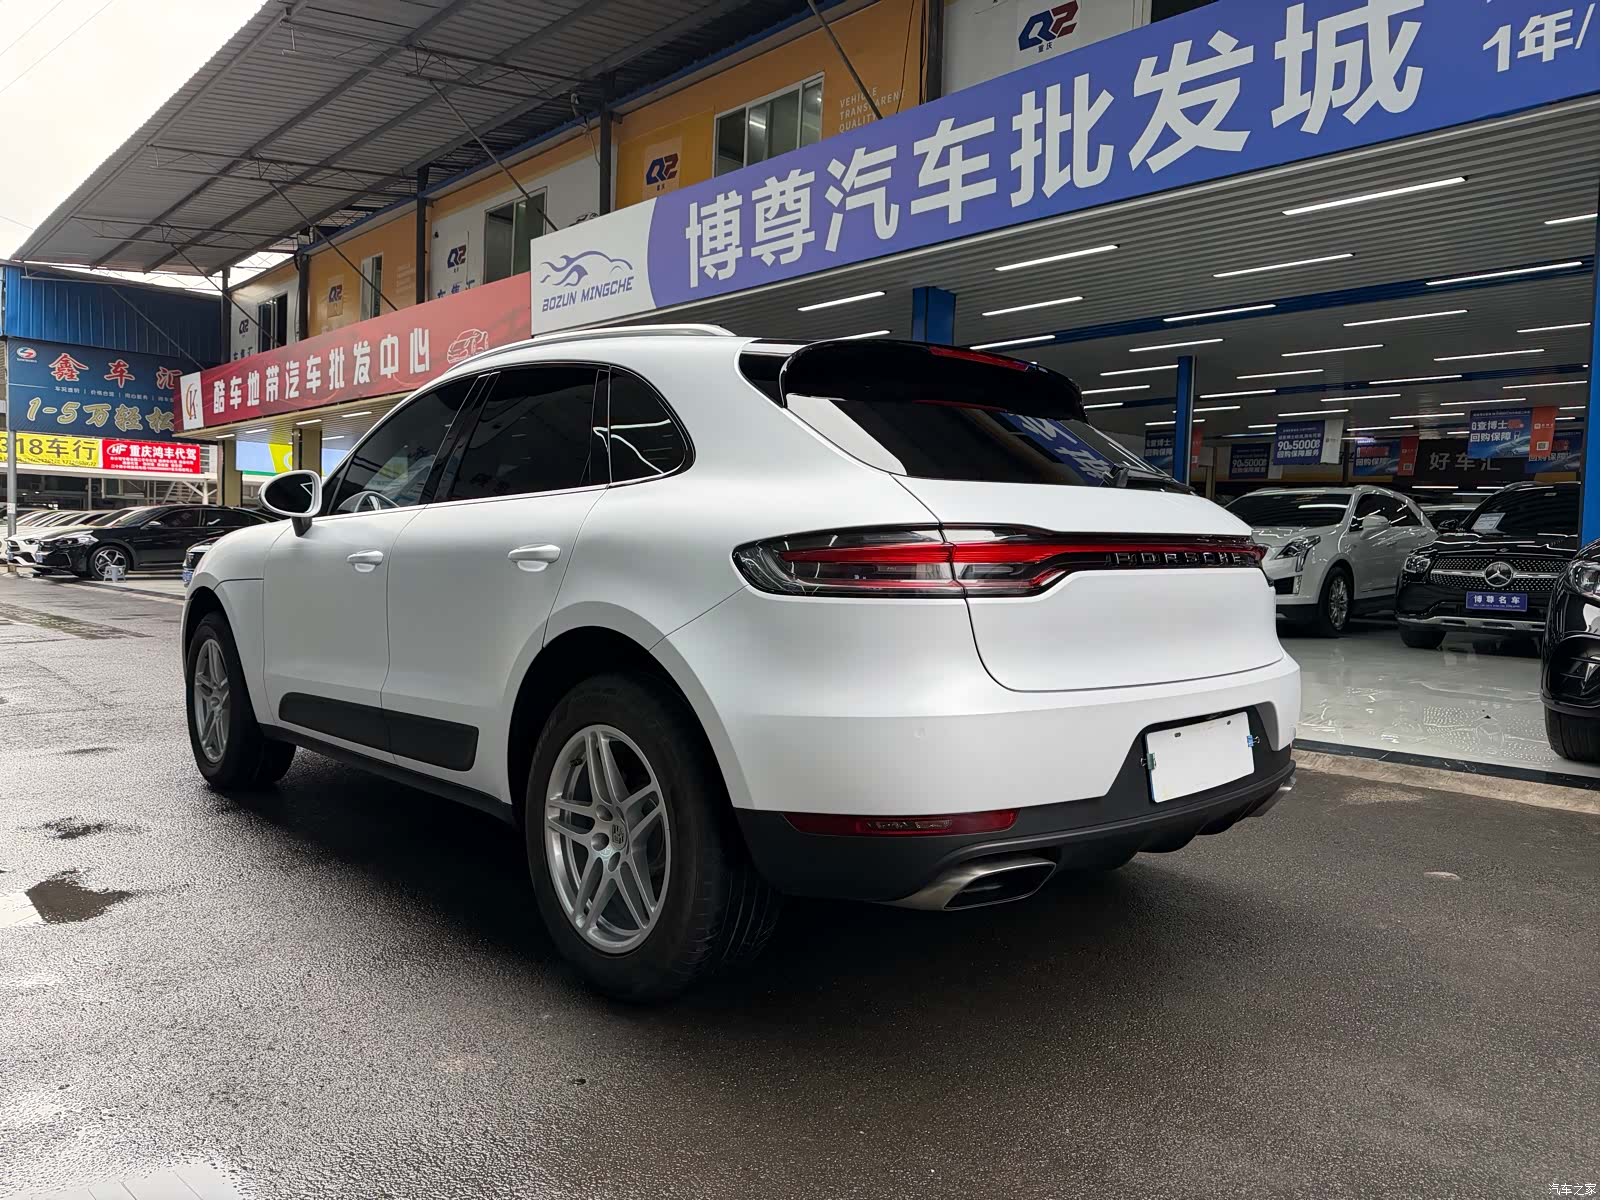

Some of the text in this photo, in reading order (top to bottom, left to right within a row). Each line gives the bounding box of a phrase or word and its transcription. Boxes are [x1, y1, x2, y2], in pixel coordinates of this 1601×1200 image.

[840, 87, 878, 108] VEHICE
[840, 89, 905, 121] TRANSARENT
[686, 0, 1424, 287] 博尊汽车批发城
[542, 276, 635, 312] BOZUN MINGCHE
[49, 353, 183, 390] 鑫车汇
[213, 327, 430, 414] 酷车地带汽车批发中心
[27, 397, 175, 433] 1-5万轻松
[129, 445, 197, 461] 重庆鸿丰代驾
[1470, 431, 1511, 443] 回购保障
[1114, 552, 1242, 565] PORSCHE
[1473, 595, 1521, 605] 博尊名车
